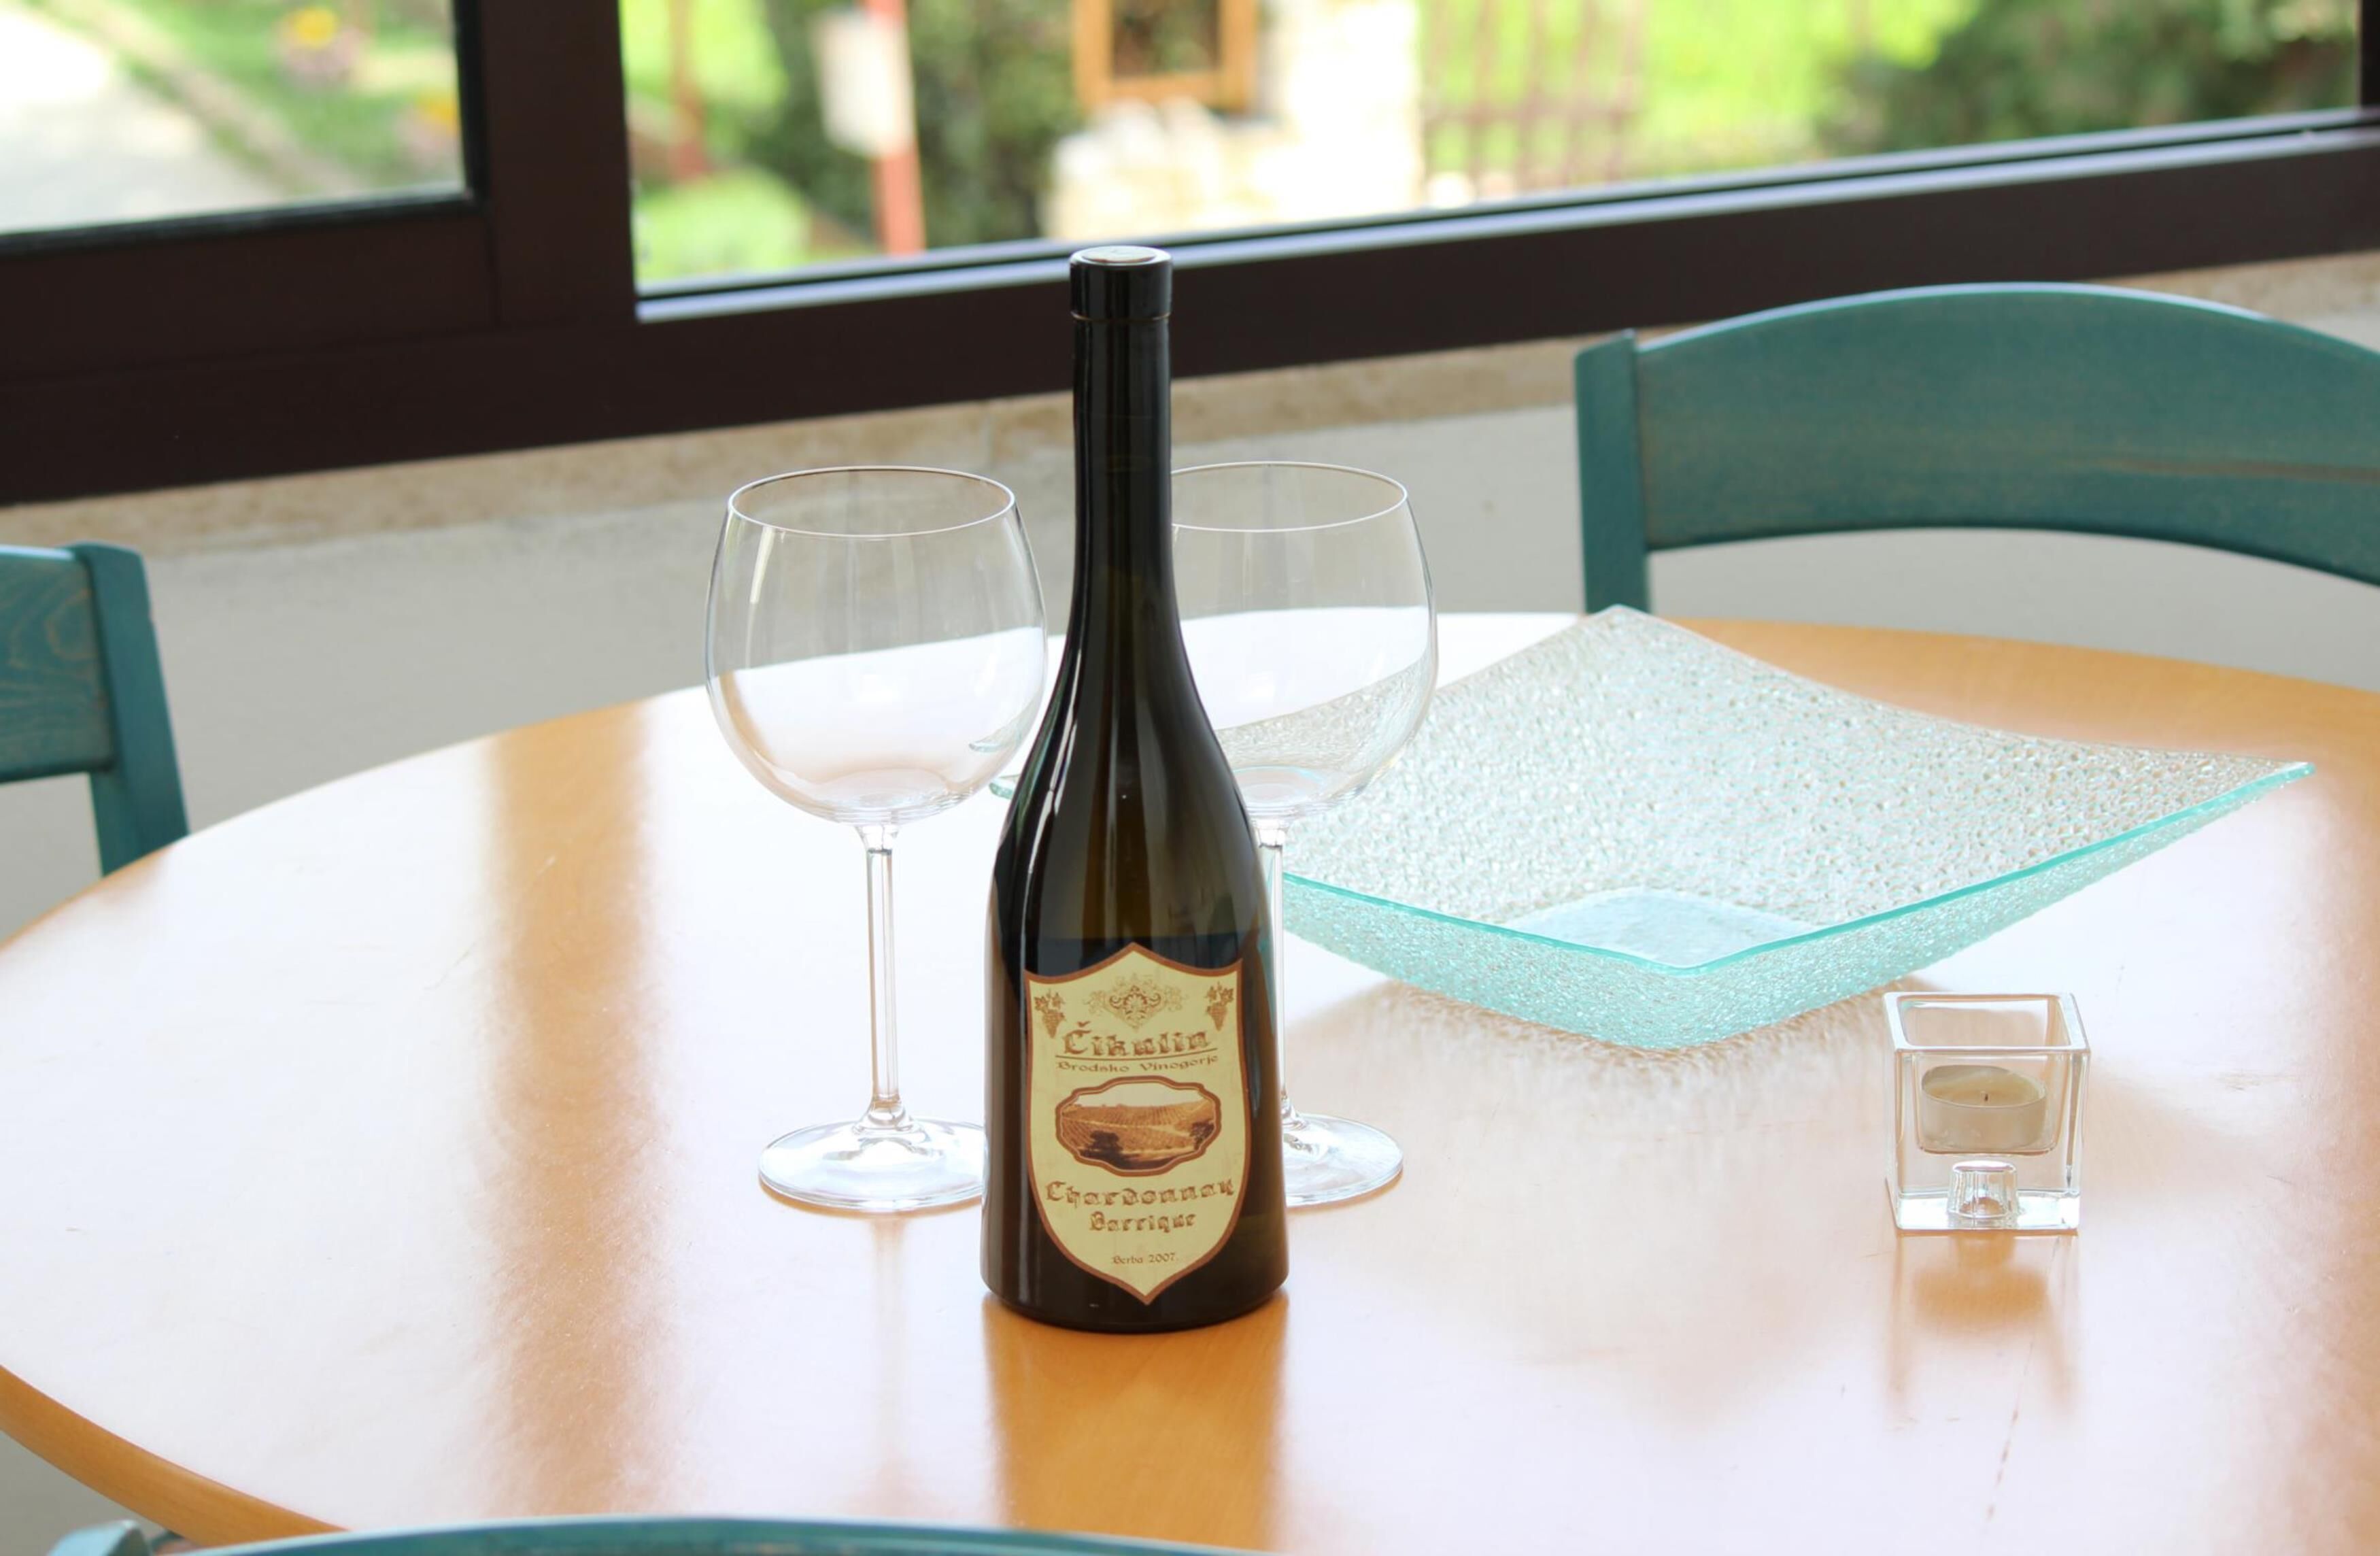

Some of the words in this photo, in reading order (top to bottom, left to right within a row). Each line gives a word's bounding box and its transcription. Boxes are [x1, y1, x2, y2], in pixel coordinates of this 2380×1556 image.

[1140, 1055, 1219, 1070] Vinogorje
[1045, 1179, 1235, 1208] Chardonnay
[1089, 1211, 1197, 1233] Barrique
[1112, 1255, 1144, 1264] Berba
